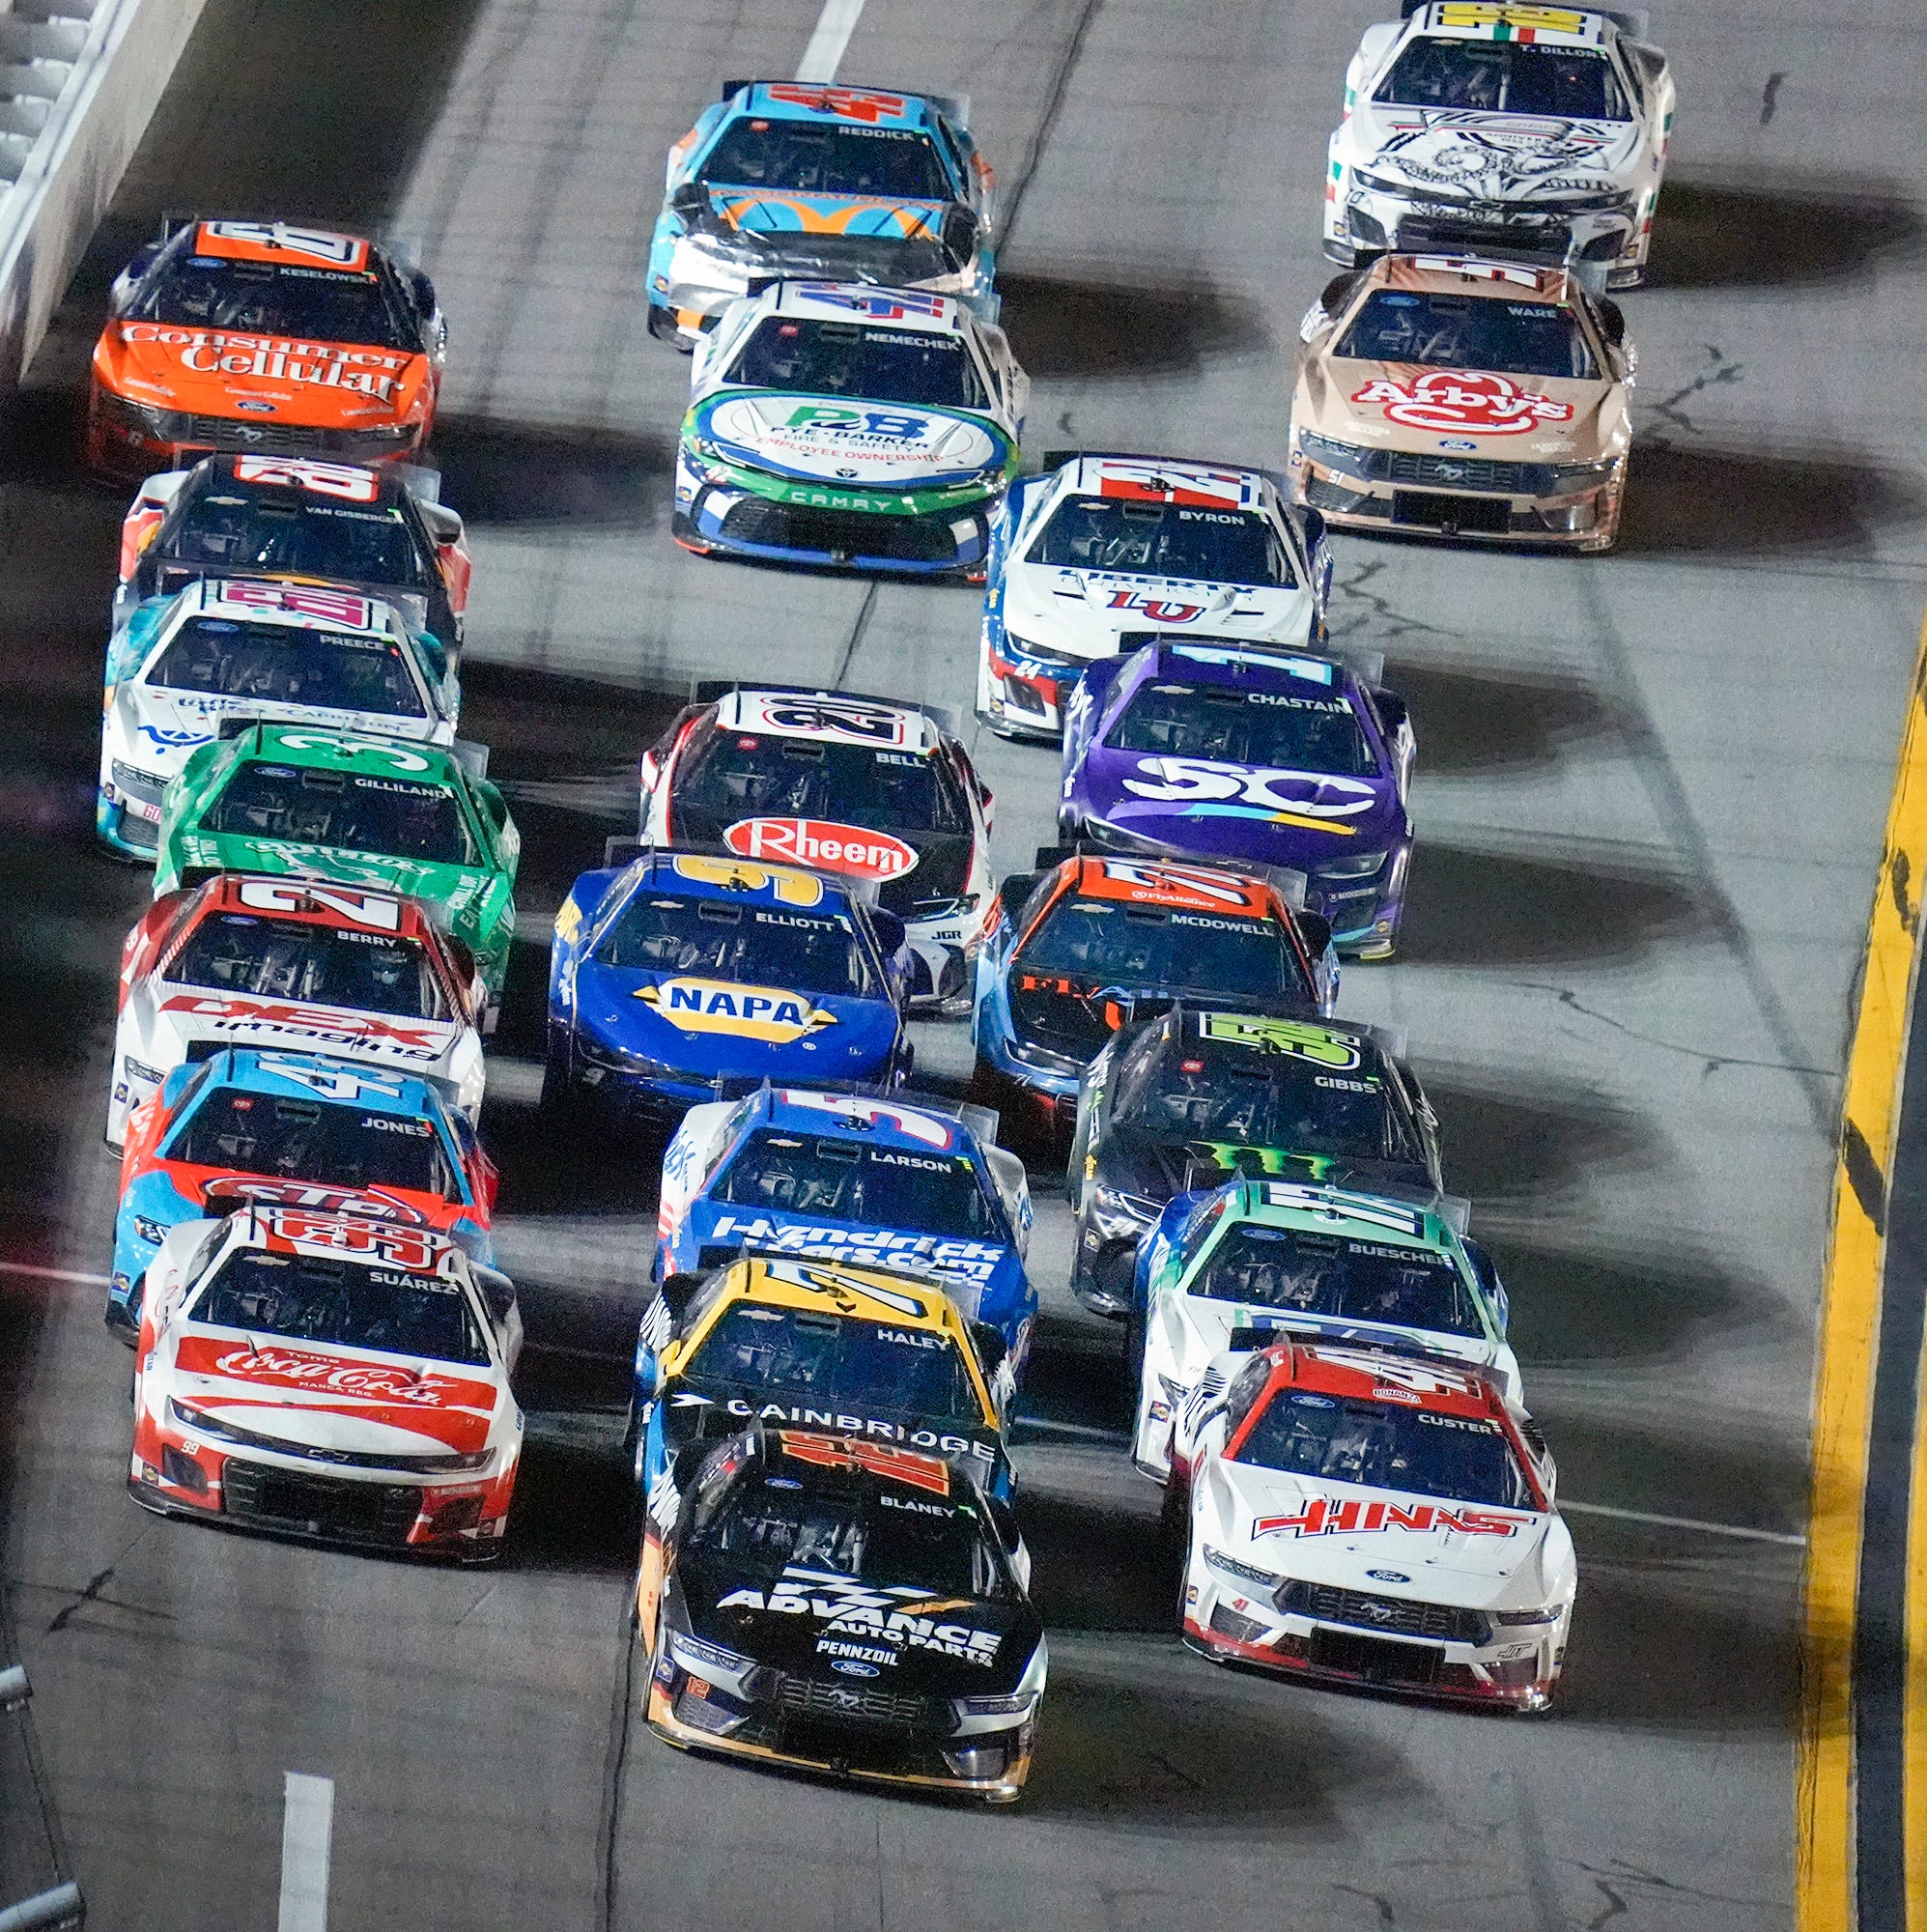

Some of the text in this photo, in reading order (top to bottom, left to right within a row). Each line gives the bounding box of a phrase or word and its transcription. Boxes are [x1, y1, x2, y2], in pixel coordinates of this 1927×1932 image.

[838, 126, 914, 141] REDDICK
[1508, 306, 1557, 318] WARE
[122, 325, 410, 369] Consumer
[866, 333, 959, 351] NEMECHEK
[181, 346, 406, 405] Cellular
[1357, 381, 1571, 419] Arby's
[756, 438, 944, 463] EMPLOYEE OWNERSHIP
[784, 433, 820, 443] FIRE
[848, 440, 917, 452] SAFETY
[1327, 469, 1345, 484] 51
[305, 501, 333, 515] VAN
[790, 492, 893, 511] CAMRY
[1178, 510, 1245, 526] BYRON
[320, 635, 385, 651] PREECE
[1014, 661, 1040, 679] 24
[1248, 694, 1349, 714] CHASTAIN
[876, 753, 926, 768] BELL
[354, 778, 449, 799] GILLILAND
[143, 805, 161, 822] 60
[749, 821, 904, 871] Rheem
[1148, 893, 1215, 908] FlyAlliance
[756, 912, 834, 932] ELLIOTT
[1172, 914, 1274, 936] MCDOWELL
[337, 930, 397, 948] BERRY
[930, 930, 962, 940] JGR
[670, 987, 805, 1025] NAPA
[158, 995, 452, 1047] DEX
[213, 1019, 440, 1063] imaging
[1315, 1075, 1377, 1094] GIBBS
[361, 1118, 431, 1136] JONES
[871, 1151, 951, 1174] LARSON
[238, 1184, 397, 1217] STP
[370, 1271, 459, 1294] SUÁREZ
[878, 1328, 948, 1351] HALEY
[215, 1351, 458, 1406] Coca-Cola
[298, 1381, 345, 1394] MARCA
[727, 1399, 997, 1463] GAINBRIDGE
[1418, 1413, 1492, 1435] CUSTER
[181, 1439, 200, 1456] 99
[880, 1495, 955, 1519] BLANEY
[1252, 1499, 1537, 1540] HAAS
[1373, 1570, 1405, 1584] Ford
[1233, 1597, 1250, 1612] 41
[716, 1589, 1003, 1654] ADVANCE
[815, 1639, 899, 1667] PENNZOIL
[827, 1620, 995, 1668] AUTO PARTS
[840, 1661, 870, 1677] Ford
[686, 1675, 713, 1699] 12
